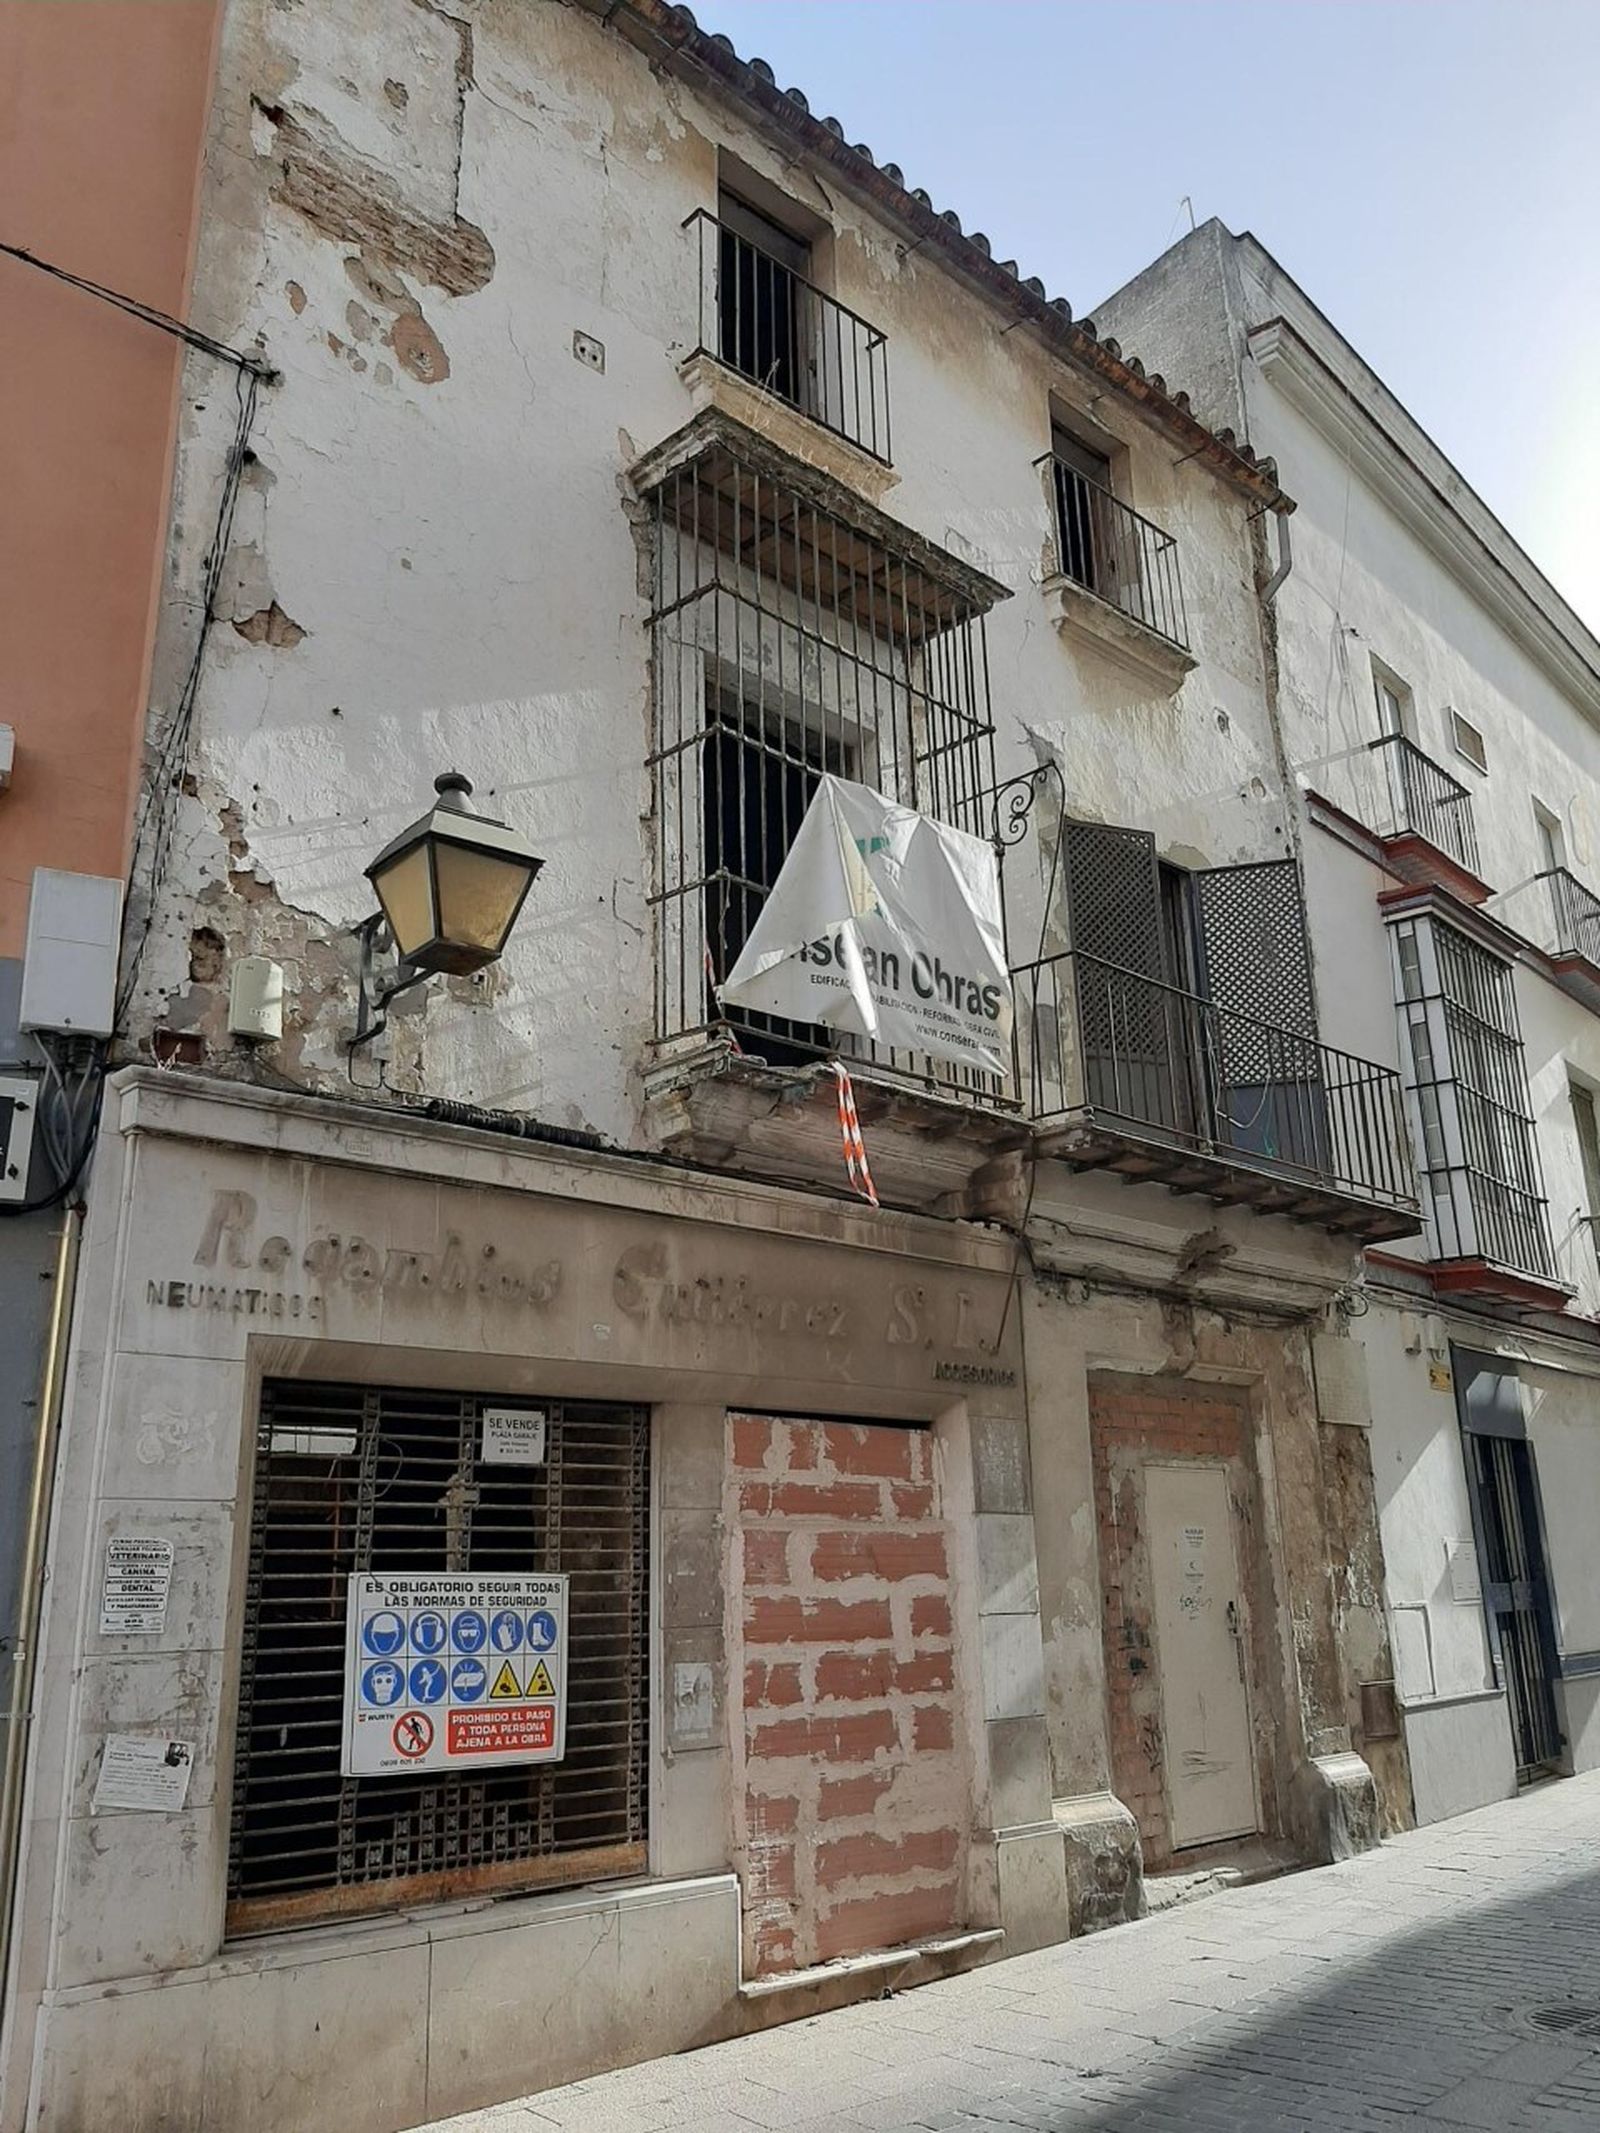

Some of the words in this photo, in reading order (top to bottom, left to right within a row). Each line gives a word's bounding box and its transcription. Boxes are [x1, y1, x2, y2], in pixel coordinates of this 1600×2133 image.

[489, 1418, 503, 1429] SE
[506, 1418, 540, 1431] VENDE
[110, 1552, 171, 1561] VETERINARIO
[121, 1568, 156, 1576] CANINA
[366, 1582, 384, 1593] ES
[390, 1582, 474, 1593] OBLIGATORIO
[478, 1582, 521, 1593] SEGUIR
[526, 1582, 561, 1593] TODAS
[384, 1596, 409, 1607] LAS
[413, 1596, 465, 1607] NORMAS
[470, 1596, 484, 1607] DE
[488, 1596, 547, 1607] SEGURIDAD
[452, 1713, 508, 1724] PROHIBIDO
[511, 1712, 523, 1721] EL
[526, 1710, 551, 1720] PASO
[458, 1727, 466, 1736] A
[470, 1725, 497, 1735] TODA
[501, 1723, 546, 1734] PERSONA
[456, 1739, 491, 1749] AJENA
[495, 1738, 503, 1746] A
[506, 1736, 518, 1745] LA
[521, 1734, 548, 1744] OBRA
